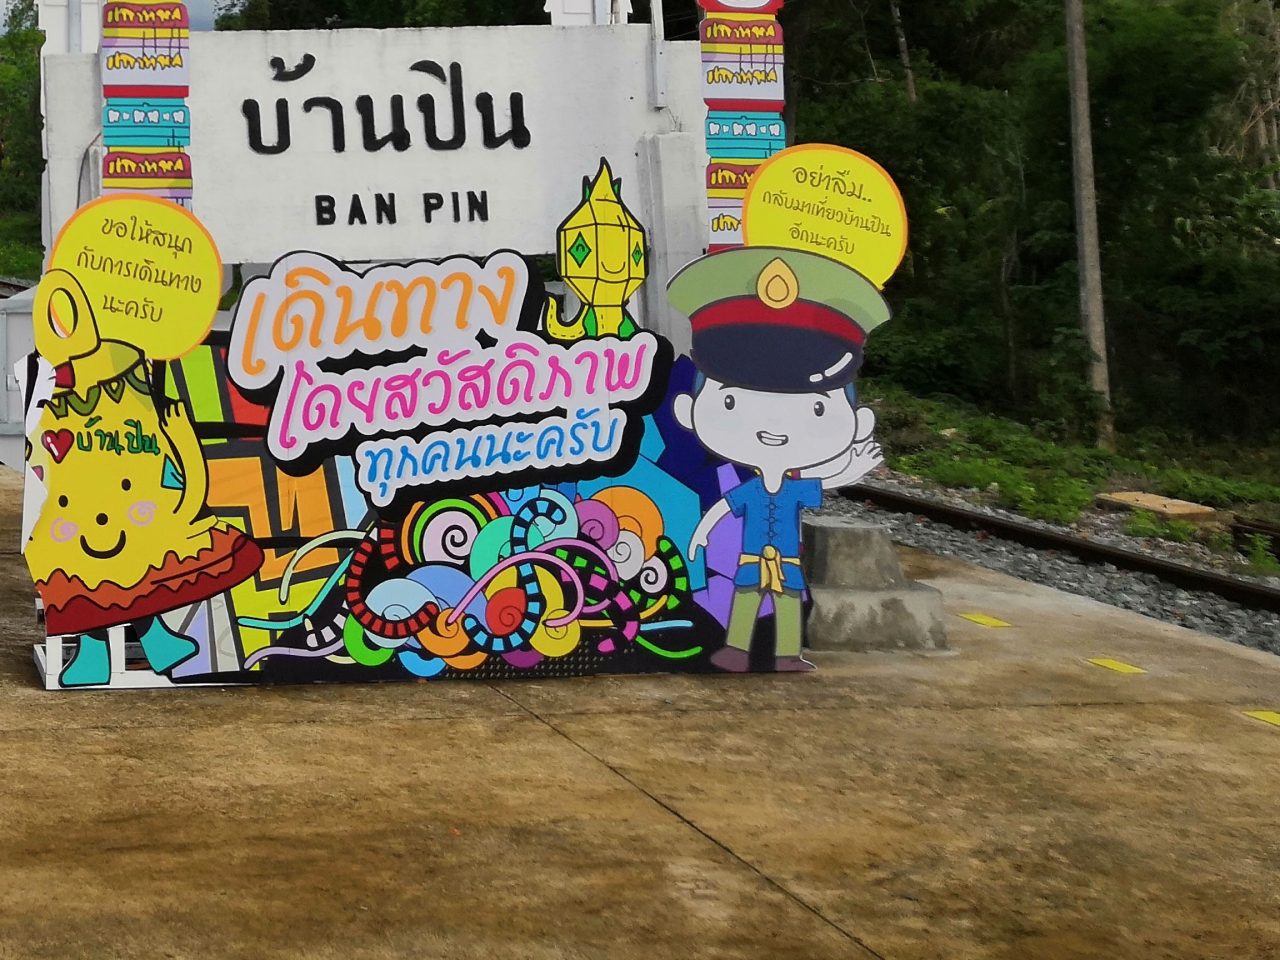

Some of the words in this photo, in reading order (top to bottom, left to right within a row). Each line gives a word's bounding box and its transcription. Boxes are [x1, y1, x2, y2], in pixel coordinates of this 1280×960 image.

[241, 53, 531, 155] บ้านปิน
[315, 193, 397, 226] BAN
[423, 190, 489, 224] PIN
[762, 190, 892, 237] กลับมาเที่ยวบ้านปิน
[101, 215, 193, 260] ขอให้สนุก
[789, 222, 855, 255] อีกนะครับ
[76, 245, 202, 294] กับการเดินทาง
[102, 294, 163, 323] นะครับ
[240, 264, 518, 377] เดินทาง
[280, 342, 648, 450] โดยสวัสดิภาพ
[363, 406, 619, 497] ทุกคนนะครับ
